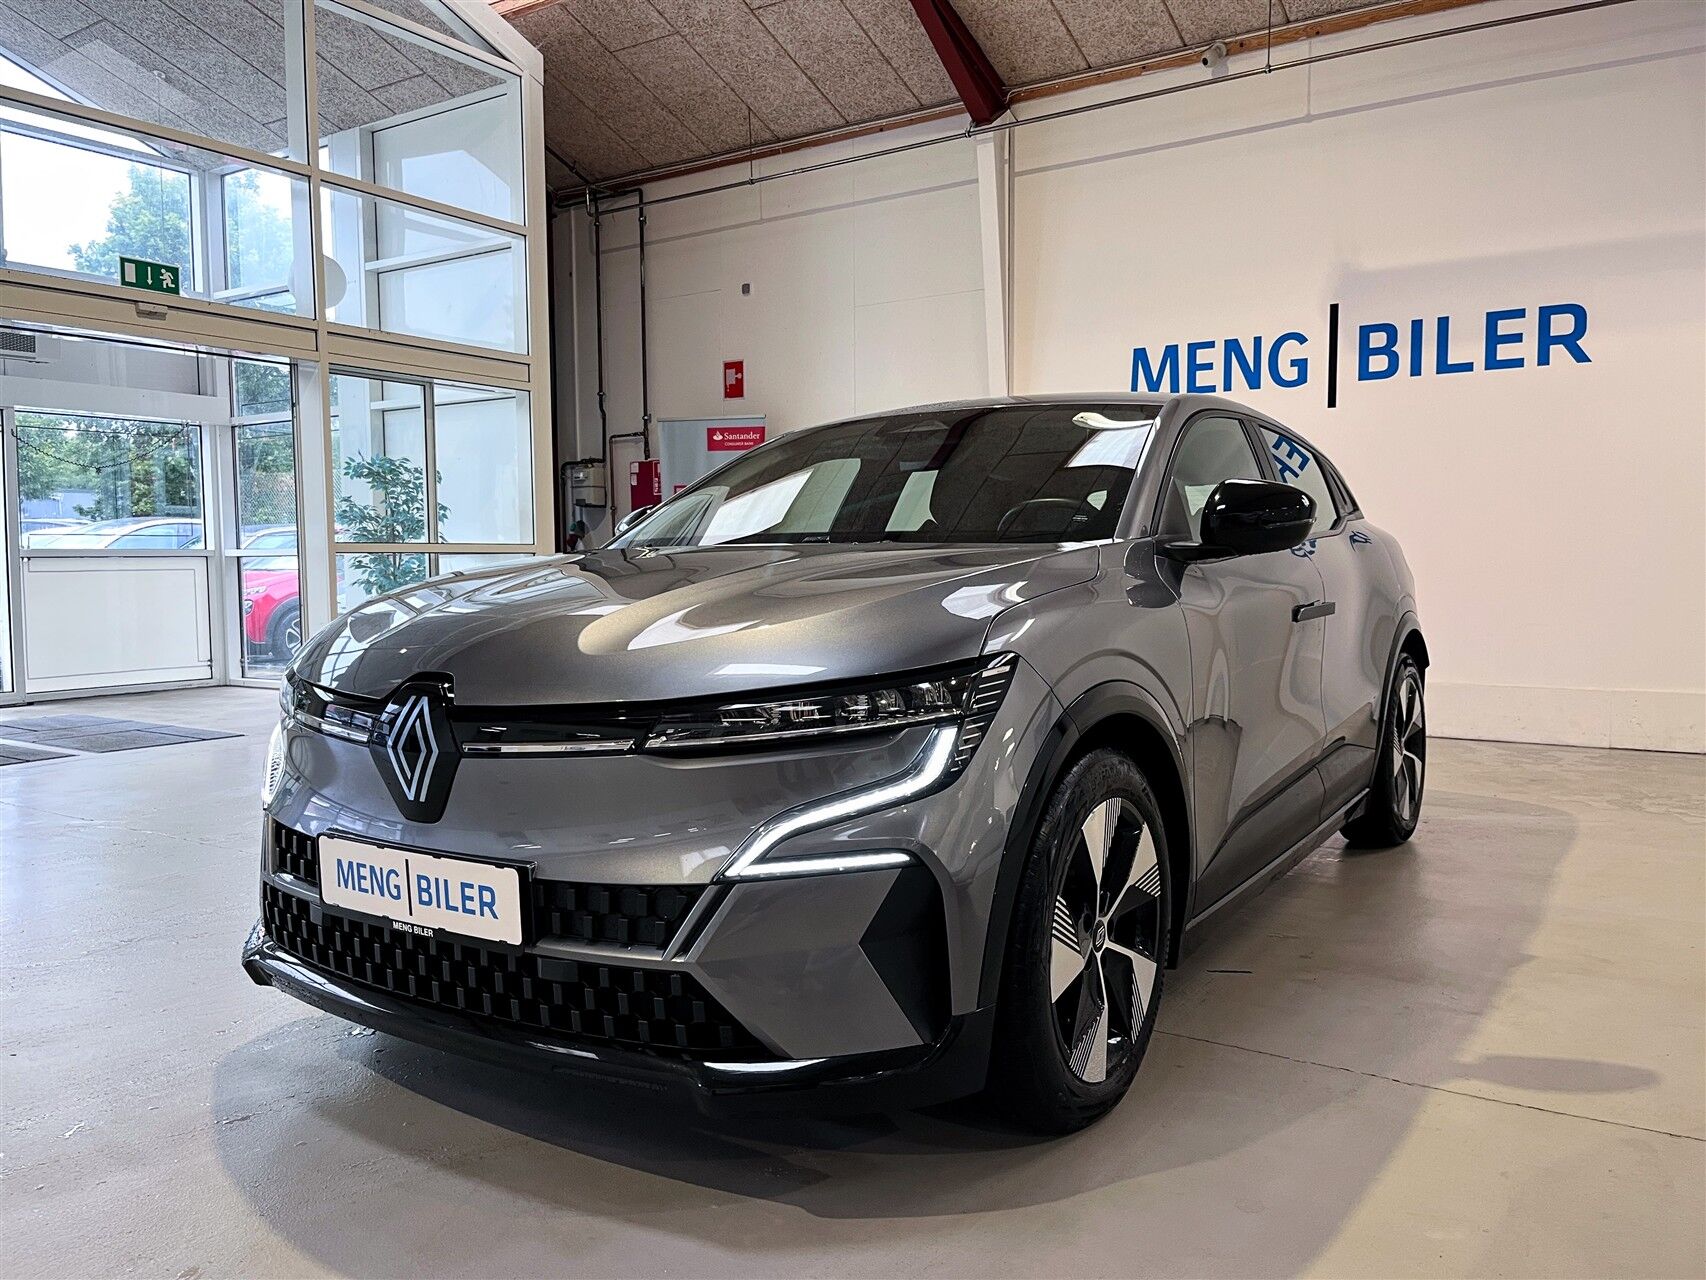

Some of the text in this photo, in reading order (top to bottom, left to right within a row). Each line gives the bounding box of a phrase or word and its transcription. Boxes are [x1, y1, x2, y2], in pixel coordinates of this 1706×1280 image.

[1131, 303, 1592, 394] MENG BILER
[724, 431, 760, 440] Santander
[336, 858, 499, 920] MENG BILER
[392, 920, 434, 938] MENG BILER
